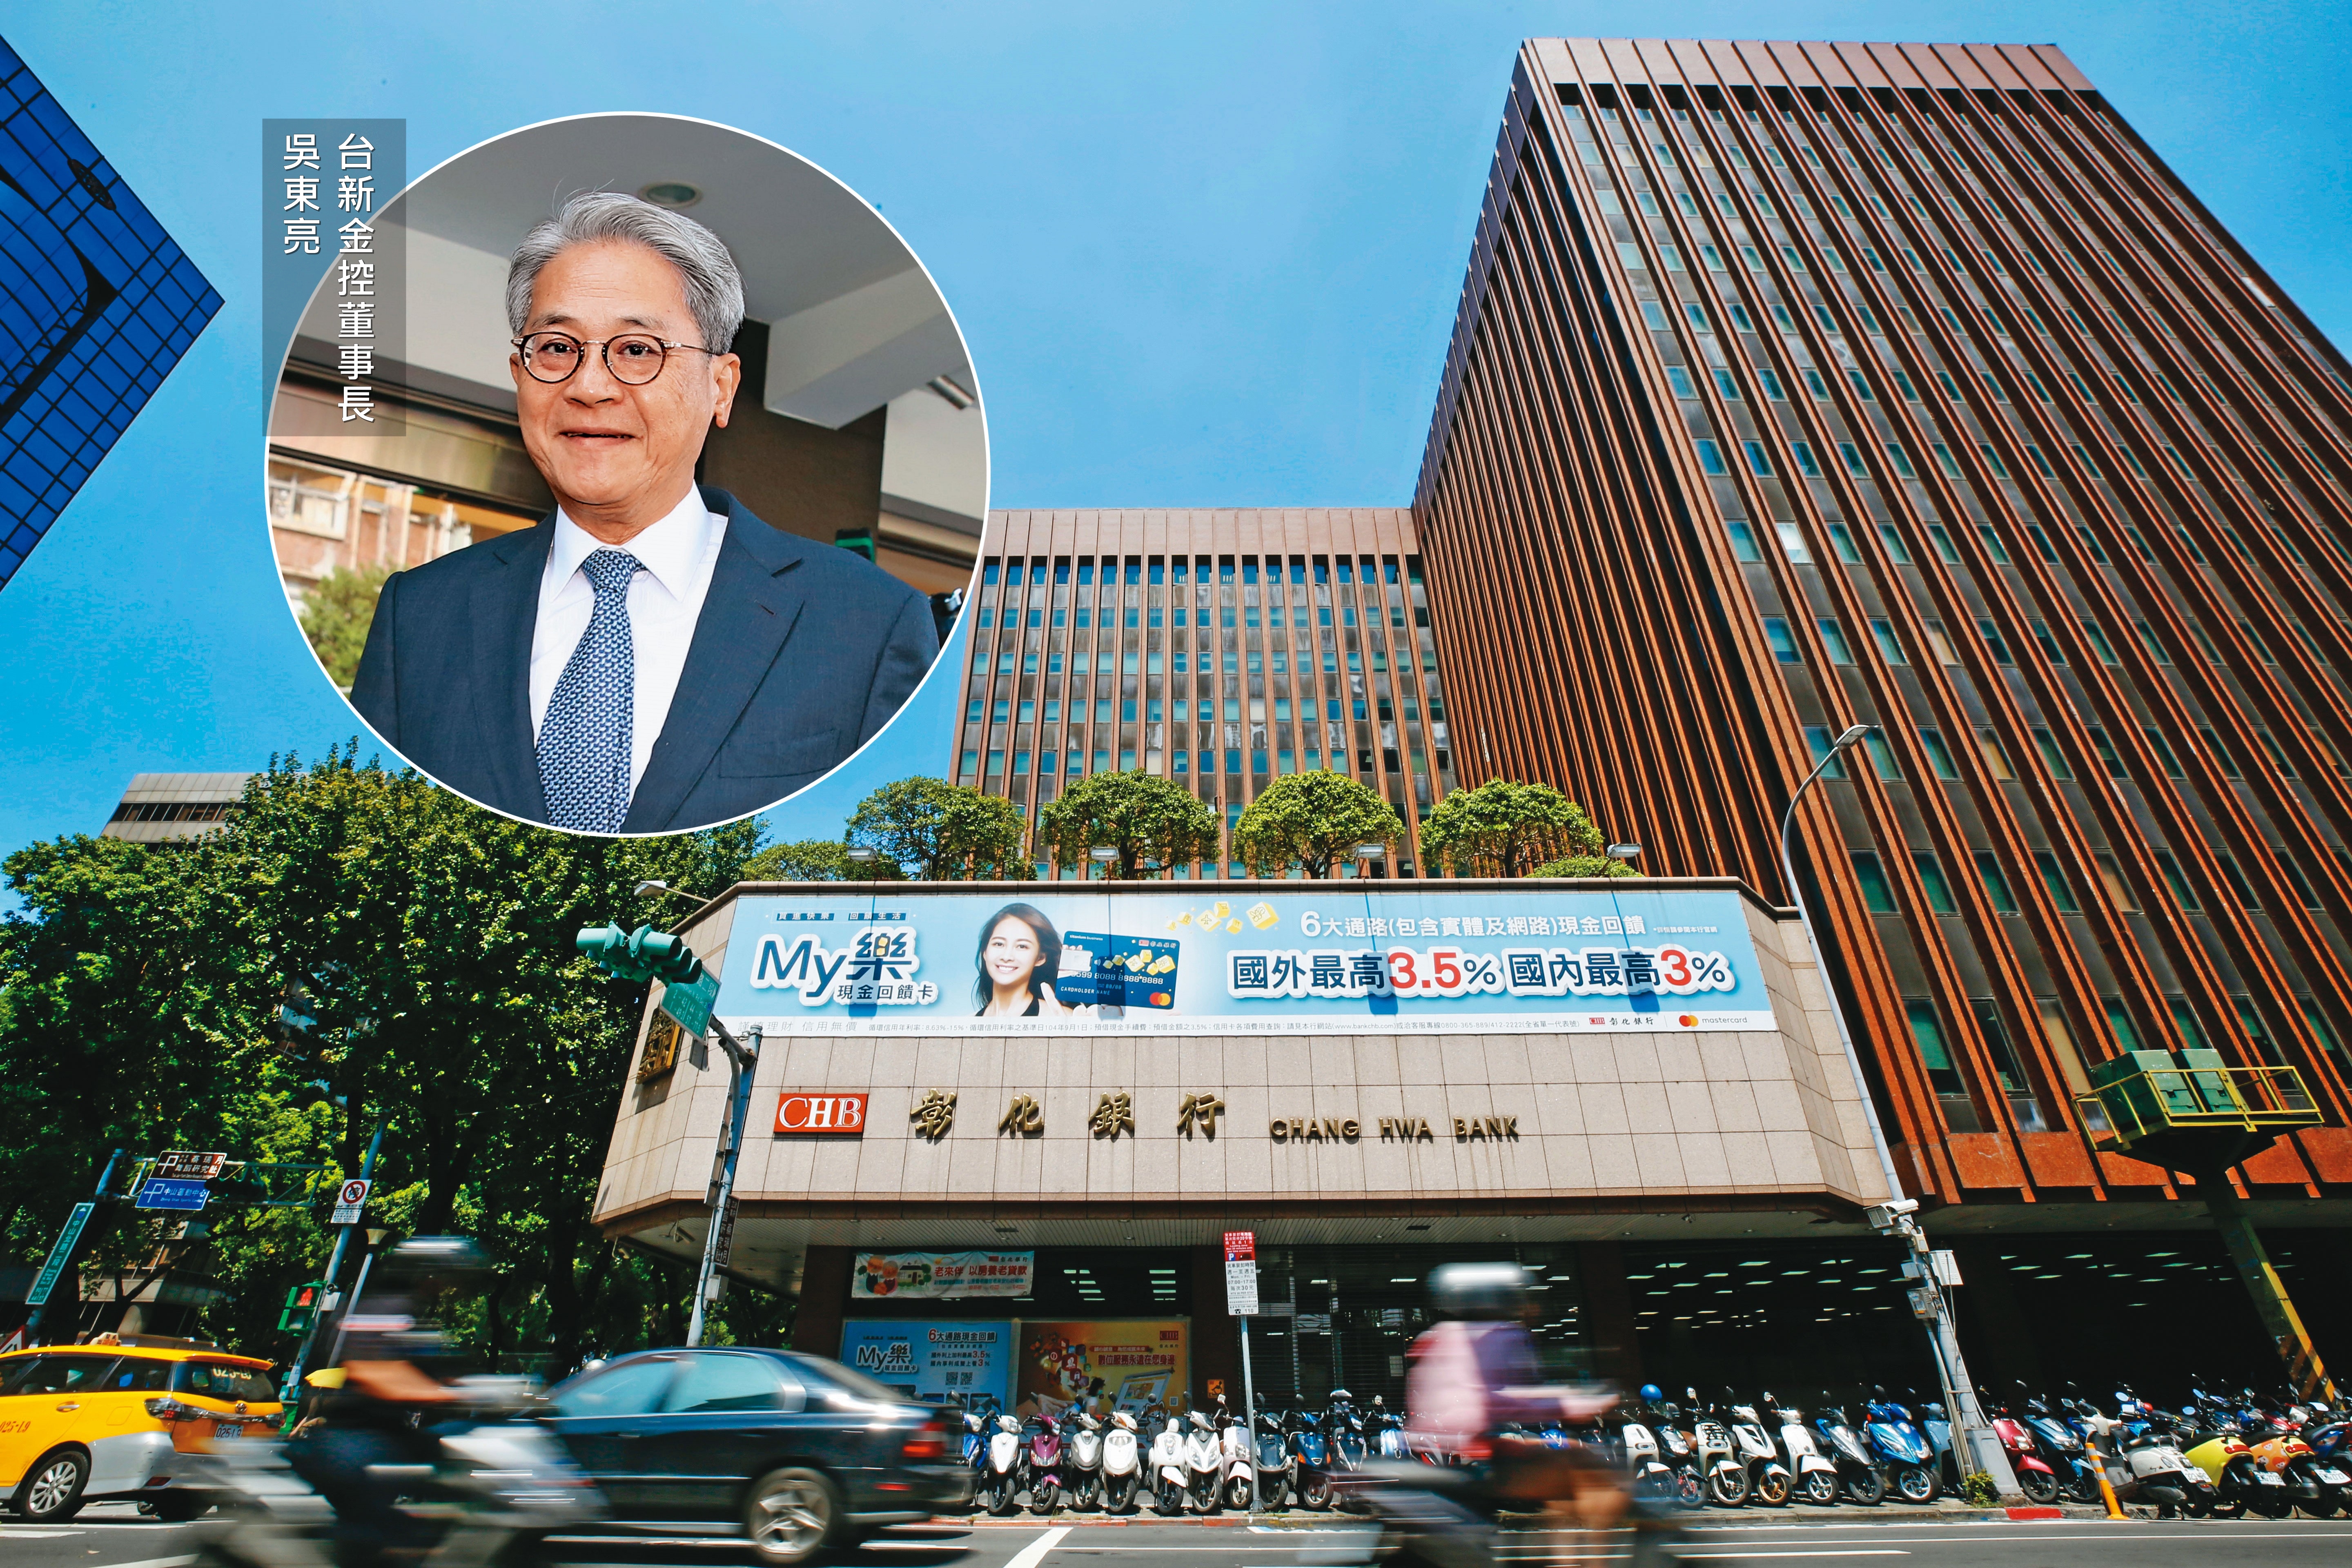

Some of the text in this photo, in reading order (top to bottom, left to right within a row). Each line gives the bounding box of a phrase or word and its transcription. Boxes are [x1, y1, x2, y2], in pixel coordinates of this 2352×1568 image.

[757, 933, 912, 998] My樂
[1234, 949, 1725, 989] 國外最高3.5% 國內最高3%
[1142, 976, 1163, 984] 8888
[837, 984, 933, 1000] 現金回饋卡
[802, 1021, 857, 1032] 信用無價
[1609, 1016, 1654, 1027] 彰化銀行
[1702, 1016, 1747, 1025] mastercard
[779, 1097, 862, 1128] CHB
[910, 1088, 1224, 1138] 彰化銀行
[1270, 1116, 1518, 1138] CHANG HWA BANK
[164, 1187, 206, 1197] 中山運動中心
[934, 1265, 1027, 1277] 老來伴 以房養老貸款
[929, 1329, 996, 1341] 6大通路現金回饋
